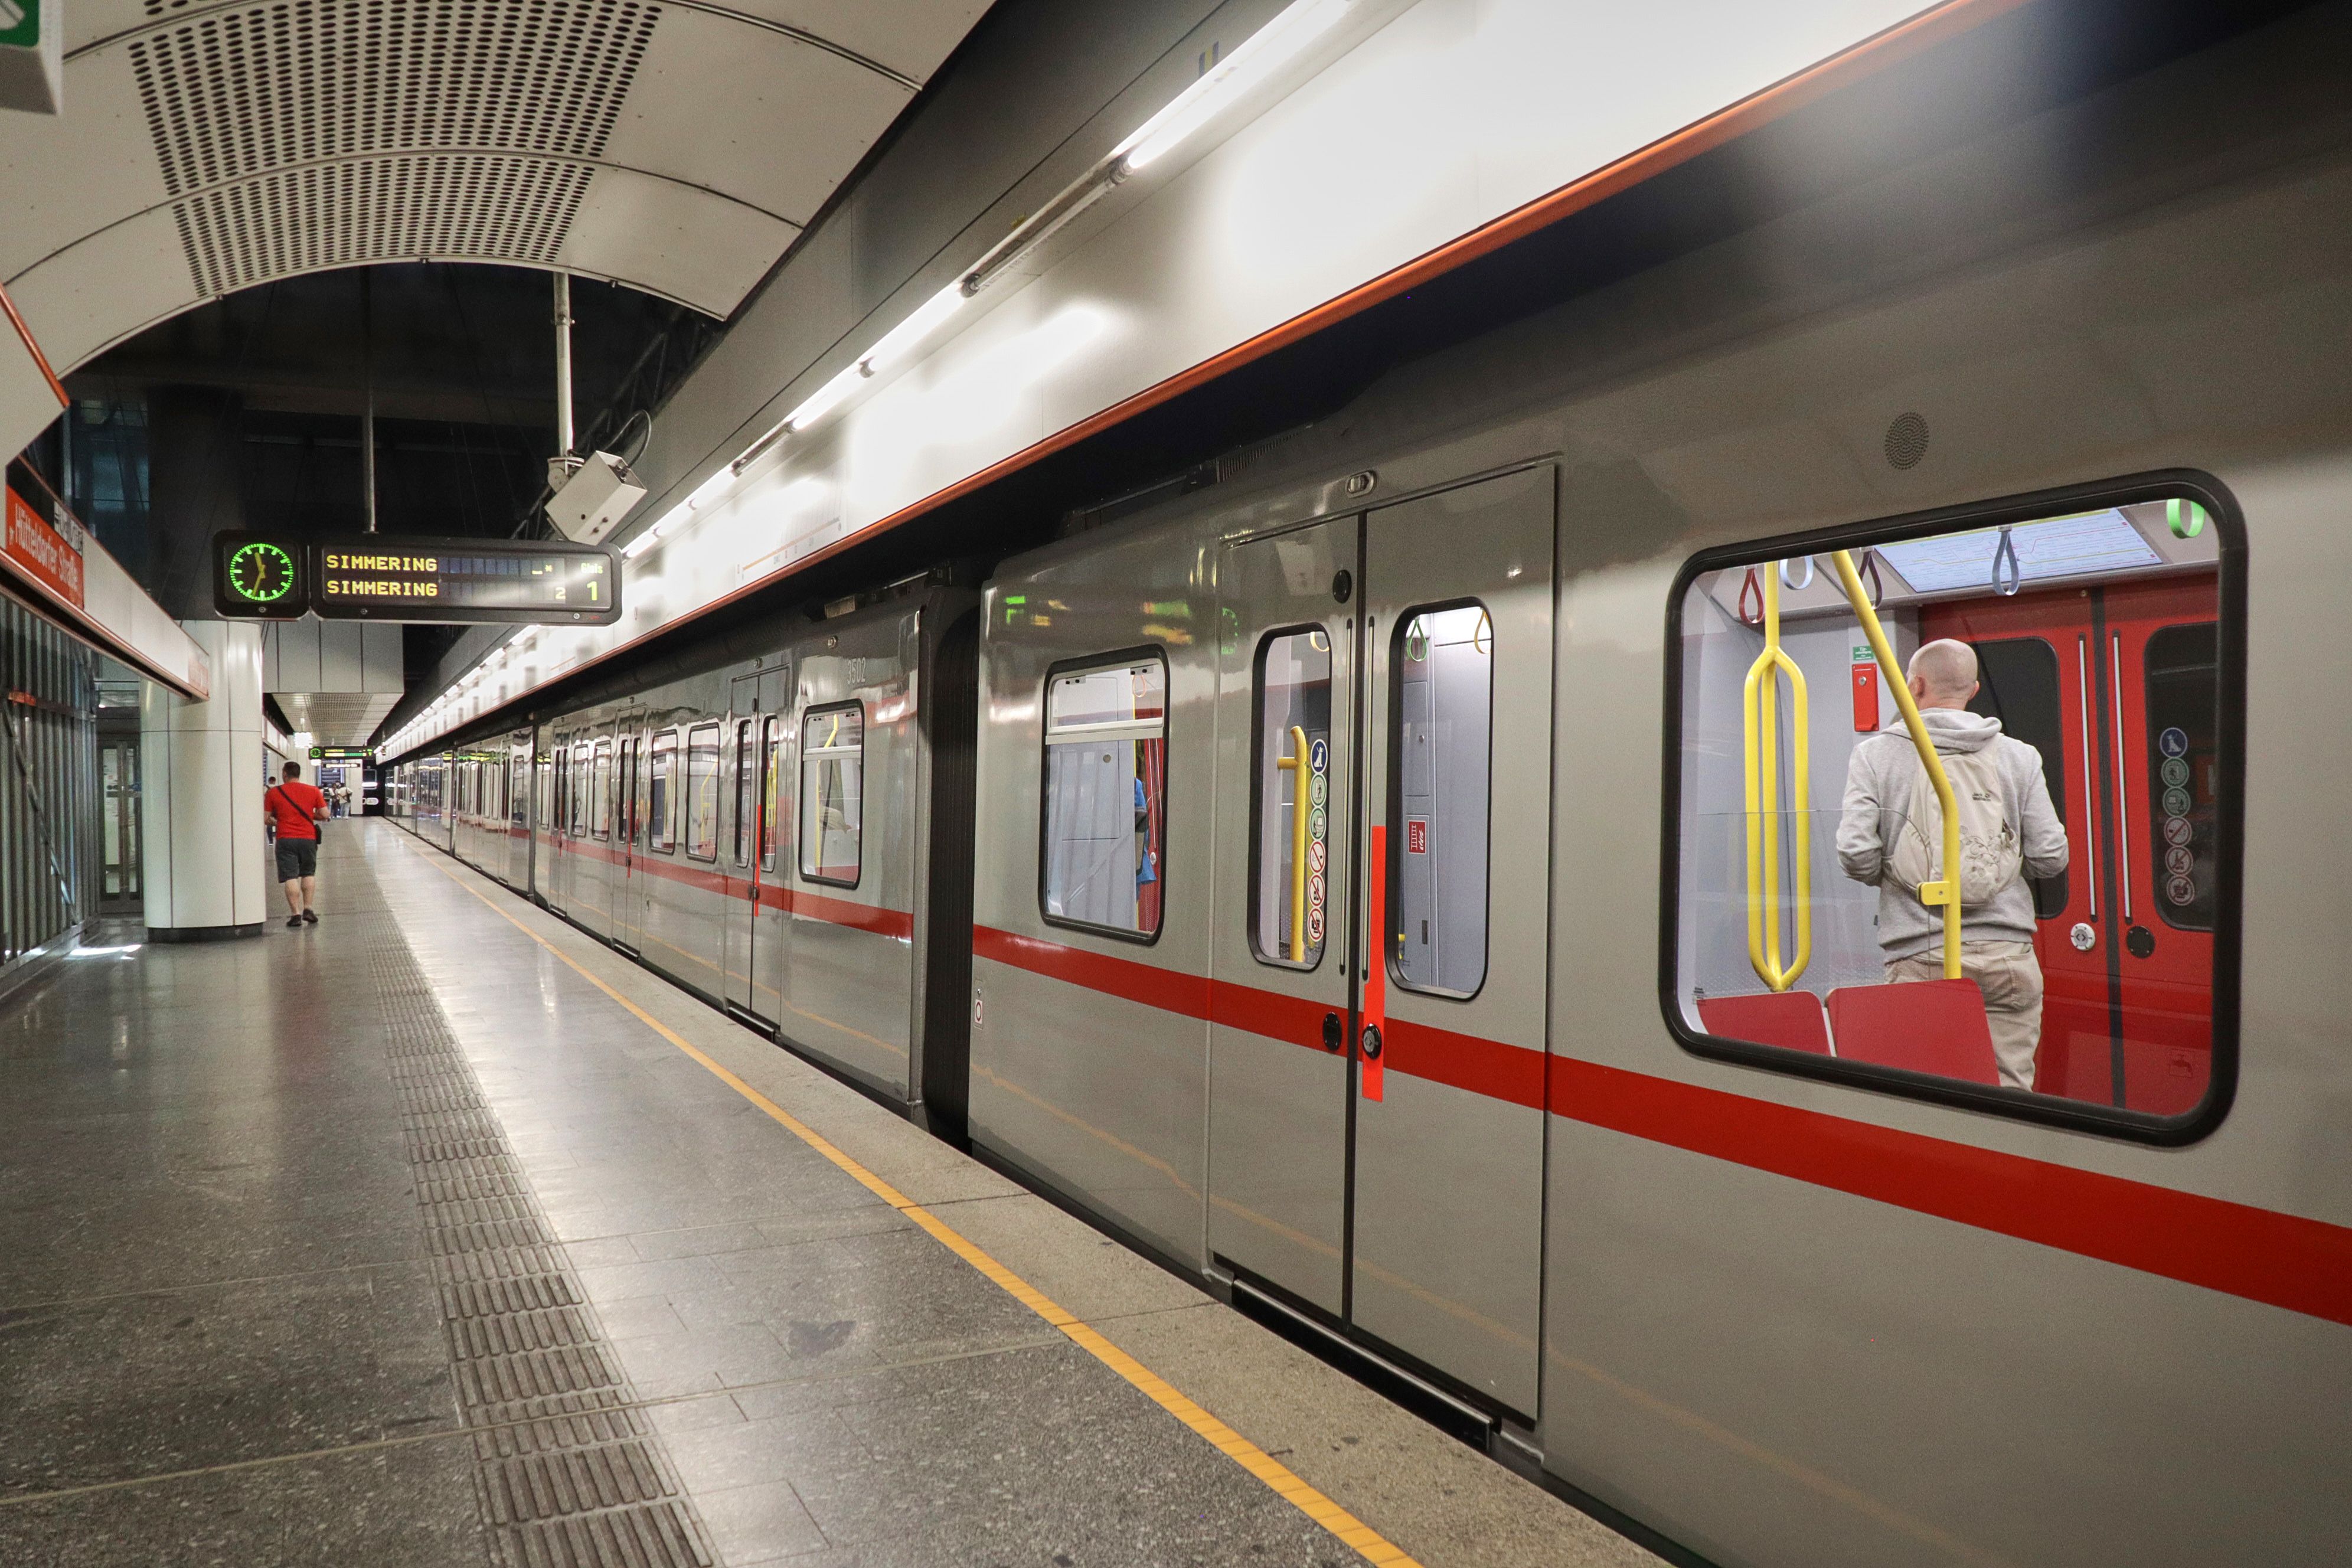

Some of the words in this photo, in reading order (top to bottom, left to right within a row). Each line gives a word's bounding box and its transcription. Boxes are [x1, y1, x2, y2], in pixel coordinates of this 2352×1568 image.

[326, 554, 437, 571] SIMMERING
[327, 580, 438, 596] SIMMERING
[555, 586, 566, 599] 2
[587, 581, 597, 600] 1
[847, 656, 866, 685] 3502
